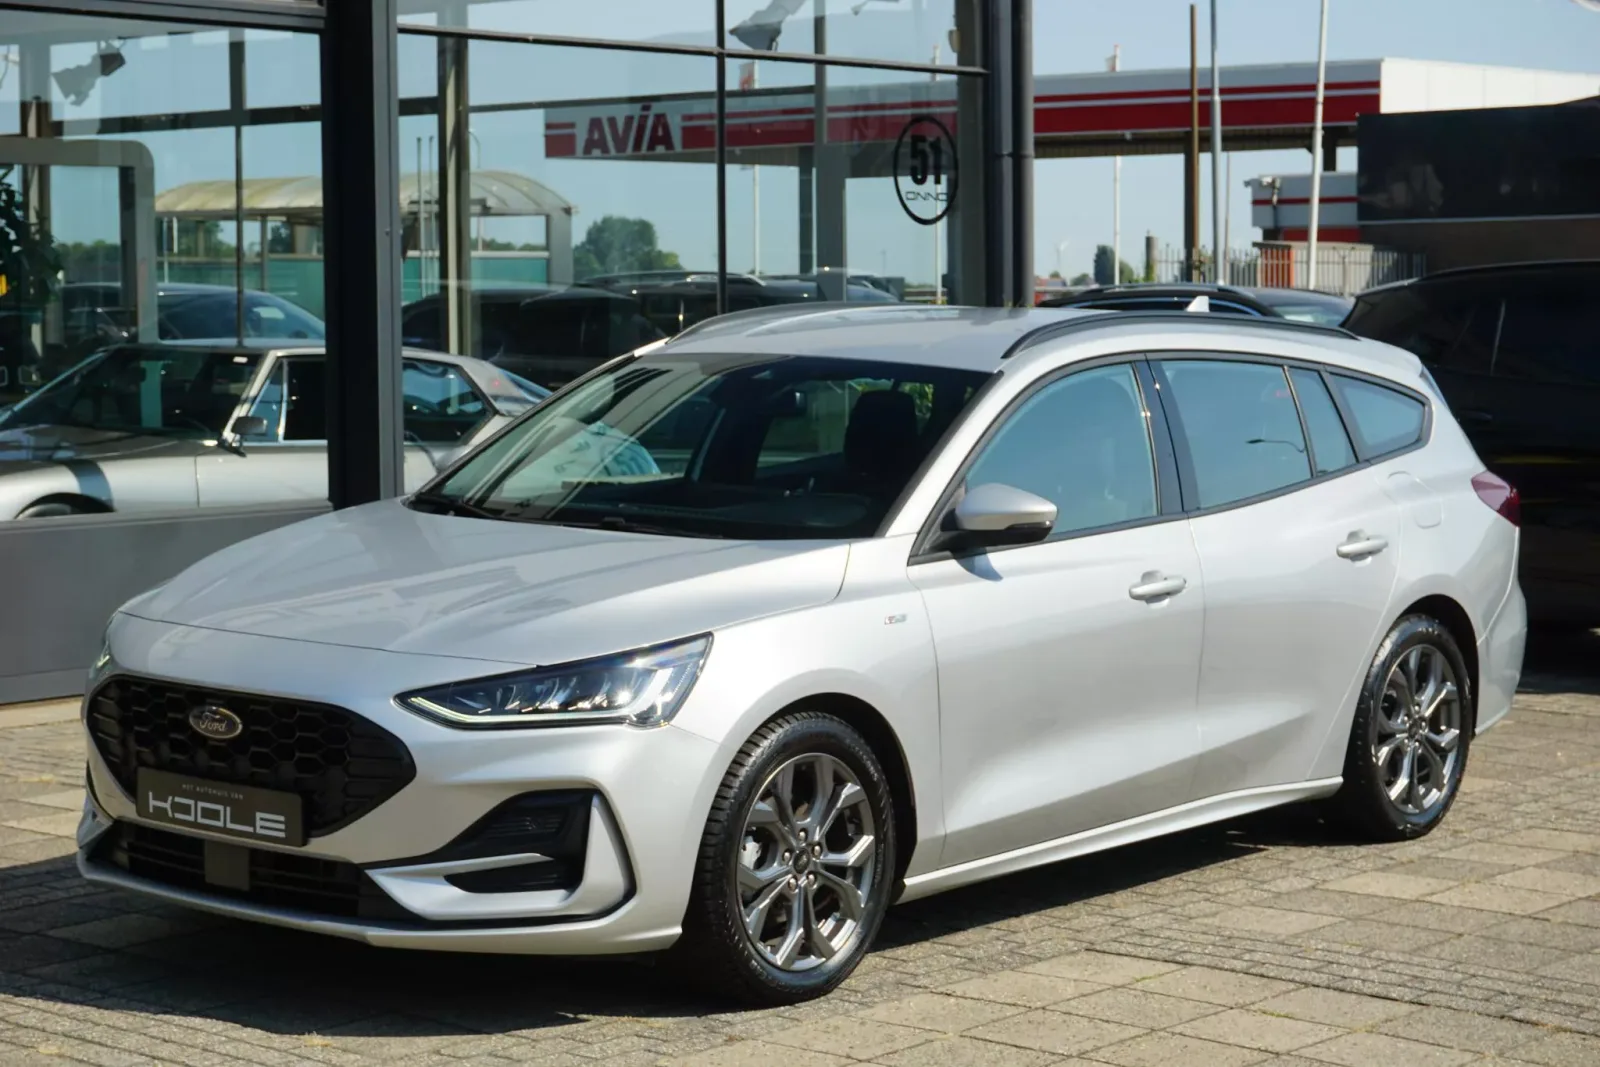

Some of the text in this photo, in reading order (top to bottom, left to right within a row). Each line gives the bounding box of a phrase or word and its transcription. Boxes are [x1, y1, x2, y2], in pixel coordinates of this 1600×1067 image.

[910, 134, 943, 186] 51
[199, 711, 228, 732] Ford
[148, 790, 286, 838] KOOLE
